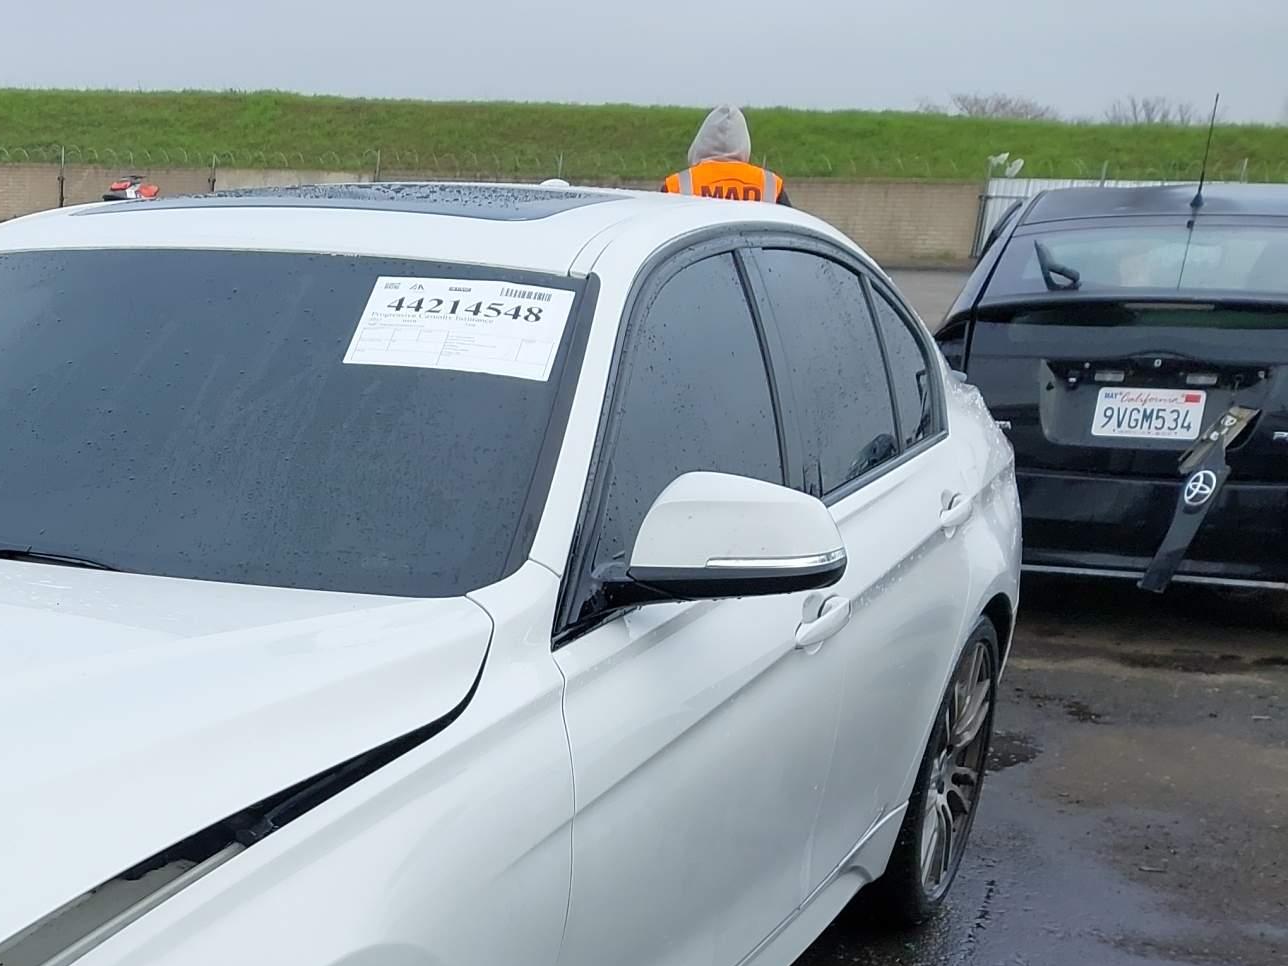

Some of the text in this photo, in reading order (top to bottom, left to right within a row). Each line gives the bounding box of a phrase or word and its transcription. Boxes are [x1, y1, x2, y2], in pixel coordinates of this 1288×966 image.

[371, 311, 417, 320] Progressive
[387, 295, 544, 323] 44214548
[1120, 391, 1179, 407] California
[1101, 406, 1192, 432] 9VGM534
